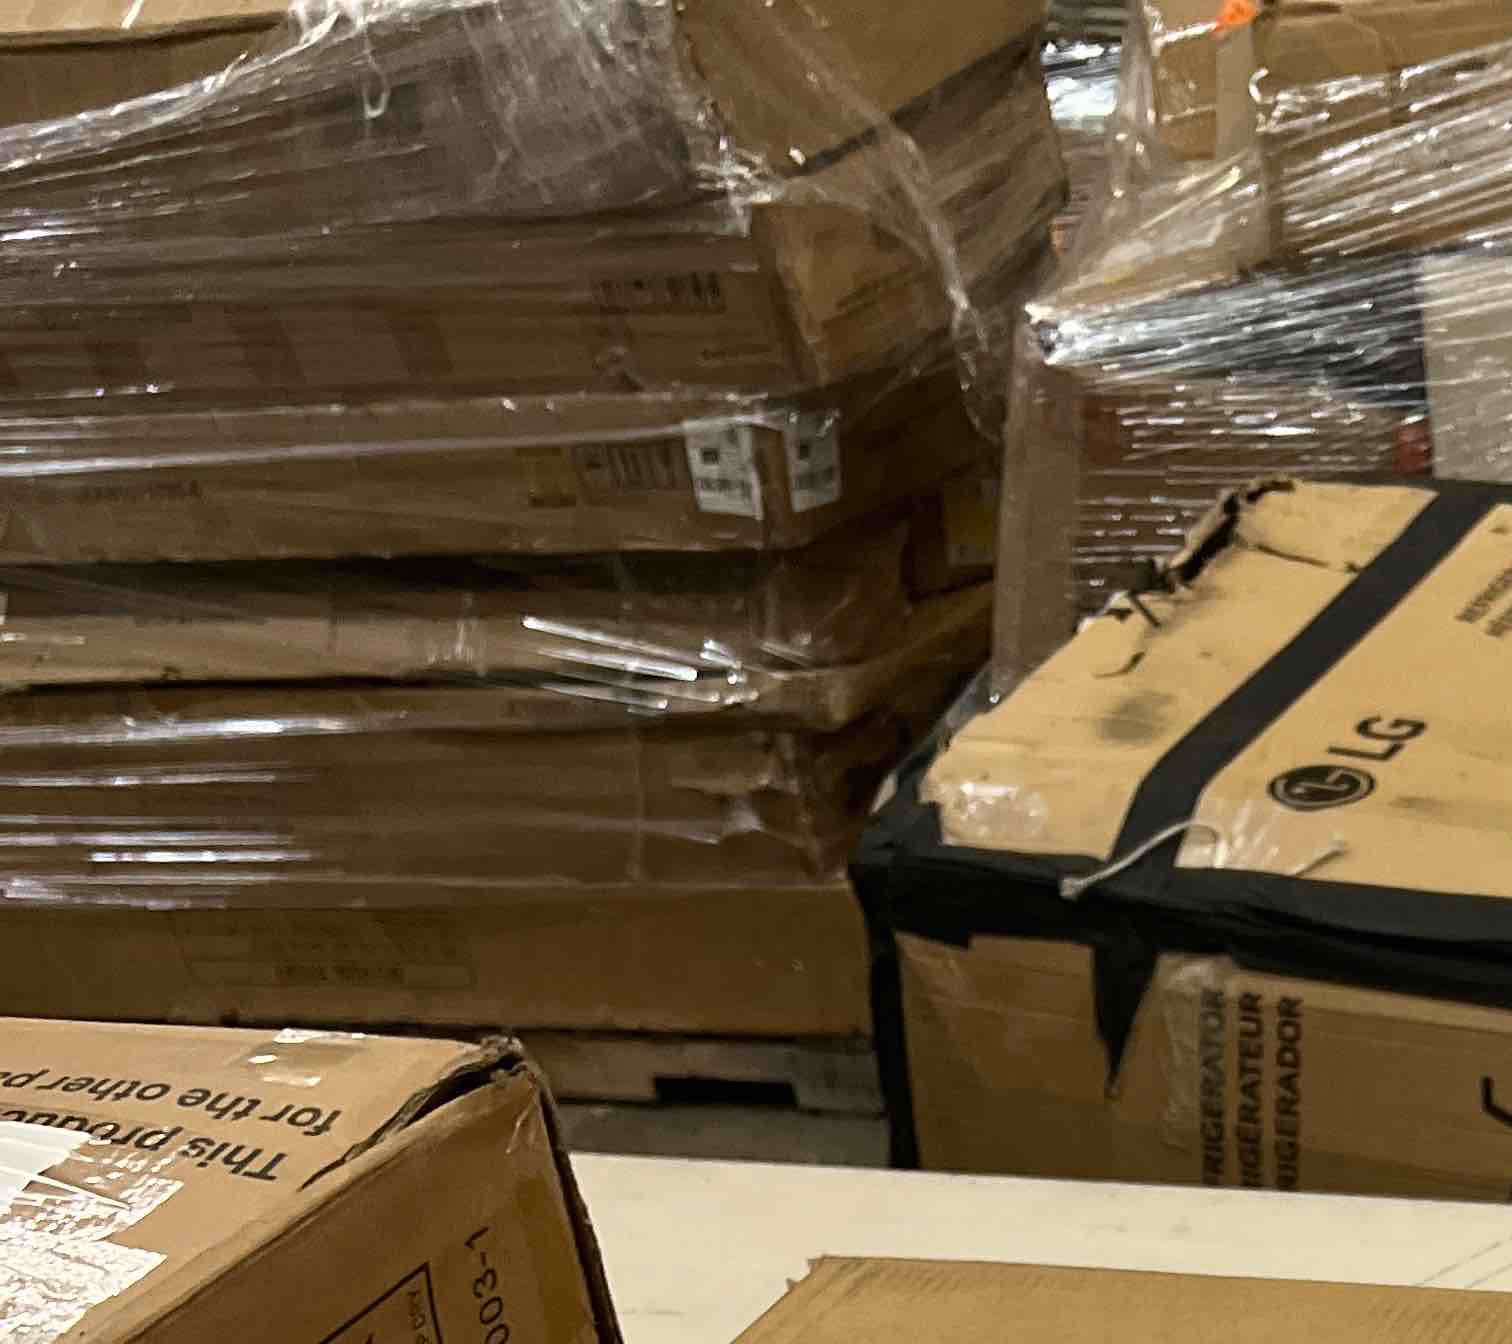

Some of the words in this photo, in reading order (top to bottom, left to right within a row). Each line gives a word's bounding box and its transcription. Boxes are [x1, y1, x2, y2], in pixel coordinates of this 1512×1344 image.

[1321, 712, 1430, 763] LG
[37, 1074, 171, 1101] other
[177, 1087, 261, 1121] the
[261, 1103, 342, 1136] for
[181, 1137, 287, 1181] This
